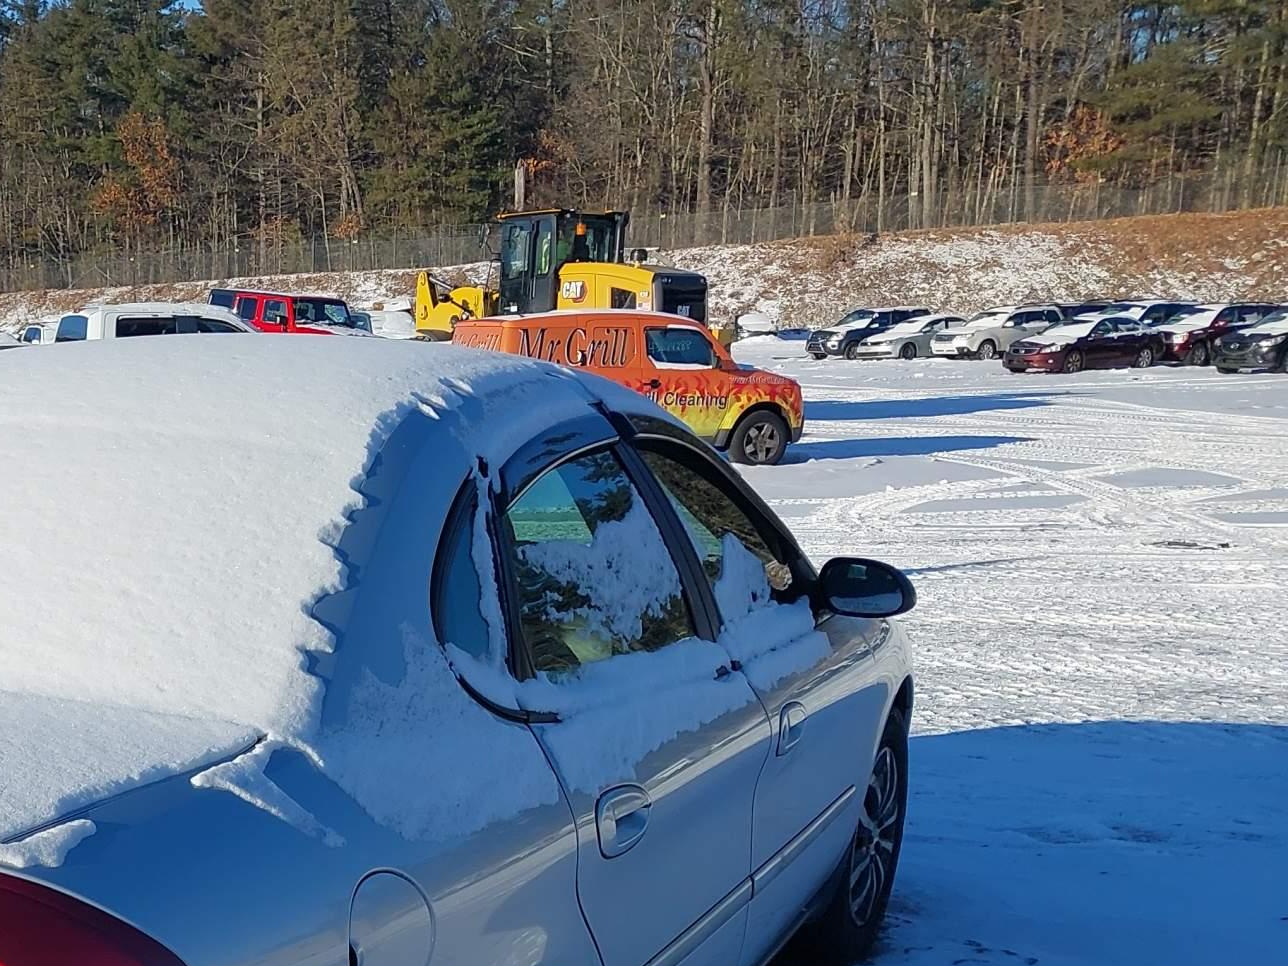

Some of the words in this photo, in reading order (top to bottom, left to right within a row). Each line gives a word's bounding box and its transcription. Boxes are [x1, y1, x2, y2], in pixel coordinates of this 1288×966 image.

[562, 281, 584, 299] CAT
[677, 305, 690, 317] CAT
[518, 328, 561, 364] Mr.
[565, 327, 629, 367] Grill
[663, 391, 728, 409] Cleaning
